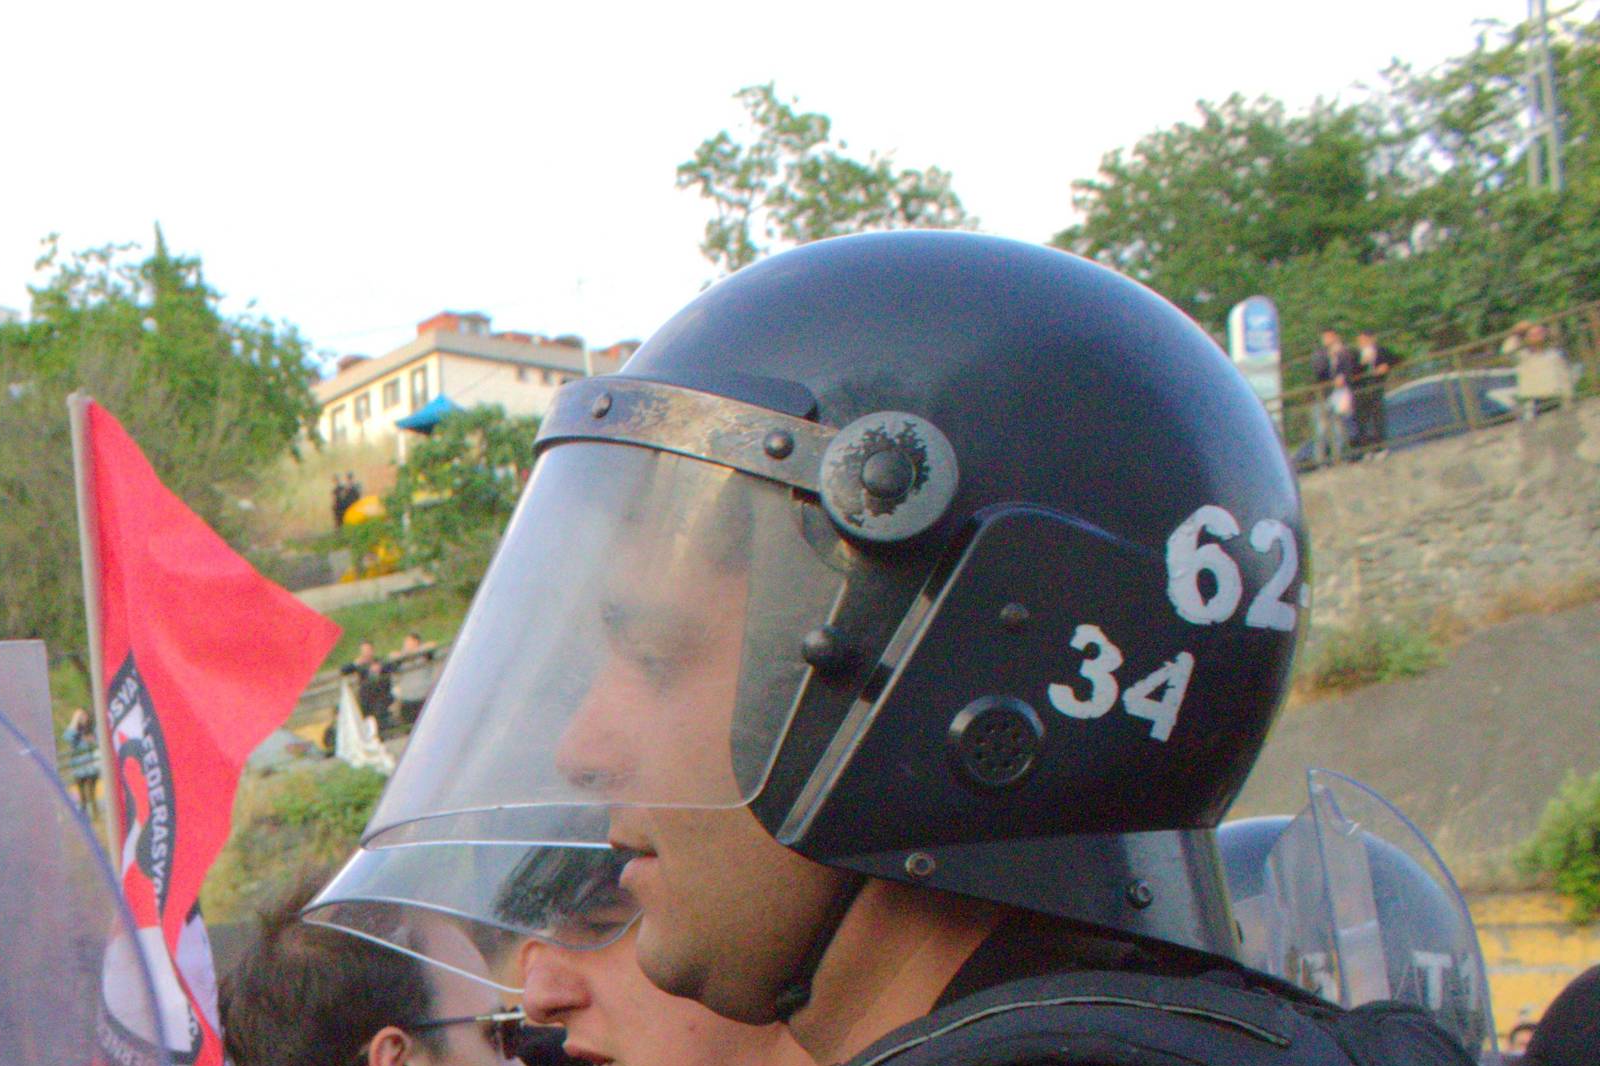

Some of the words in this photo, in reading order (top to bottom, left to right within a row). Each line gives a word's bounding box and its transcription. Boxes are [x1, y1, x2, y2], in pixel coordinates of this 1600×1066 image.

[1166, 504, 1299, 632] 62
[1047, 623, 1195, 742] 34
[142, 734, 169, 902] FEDERASYO
